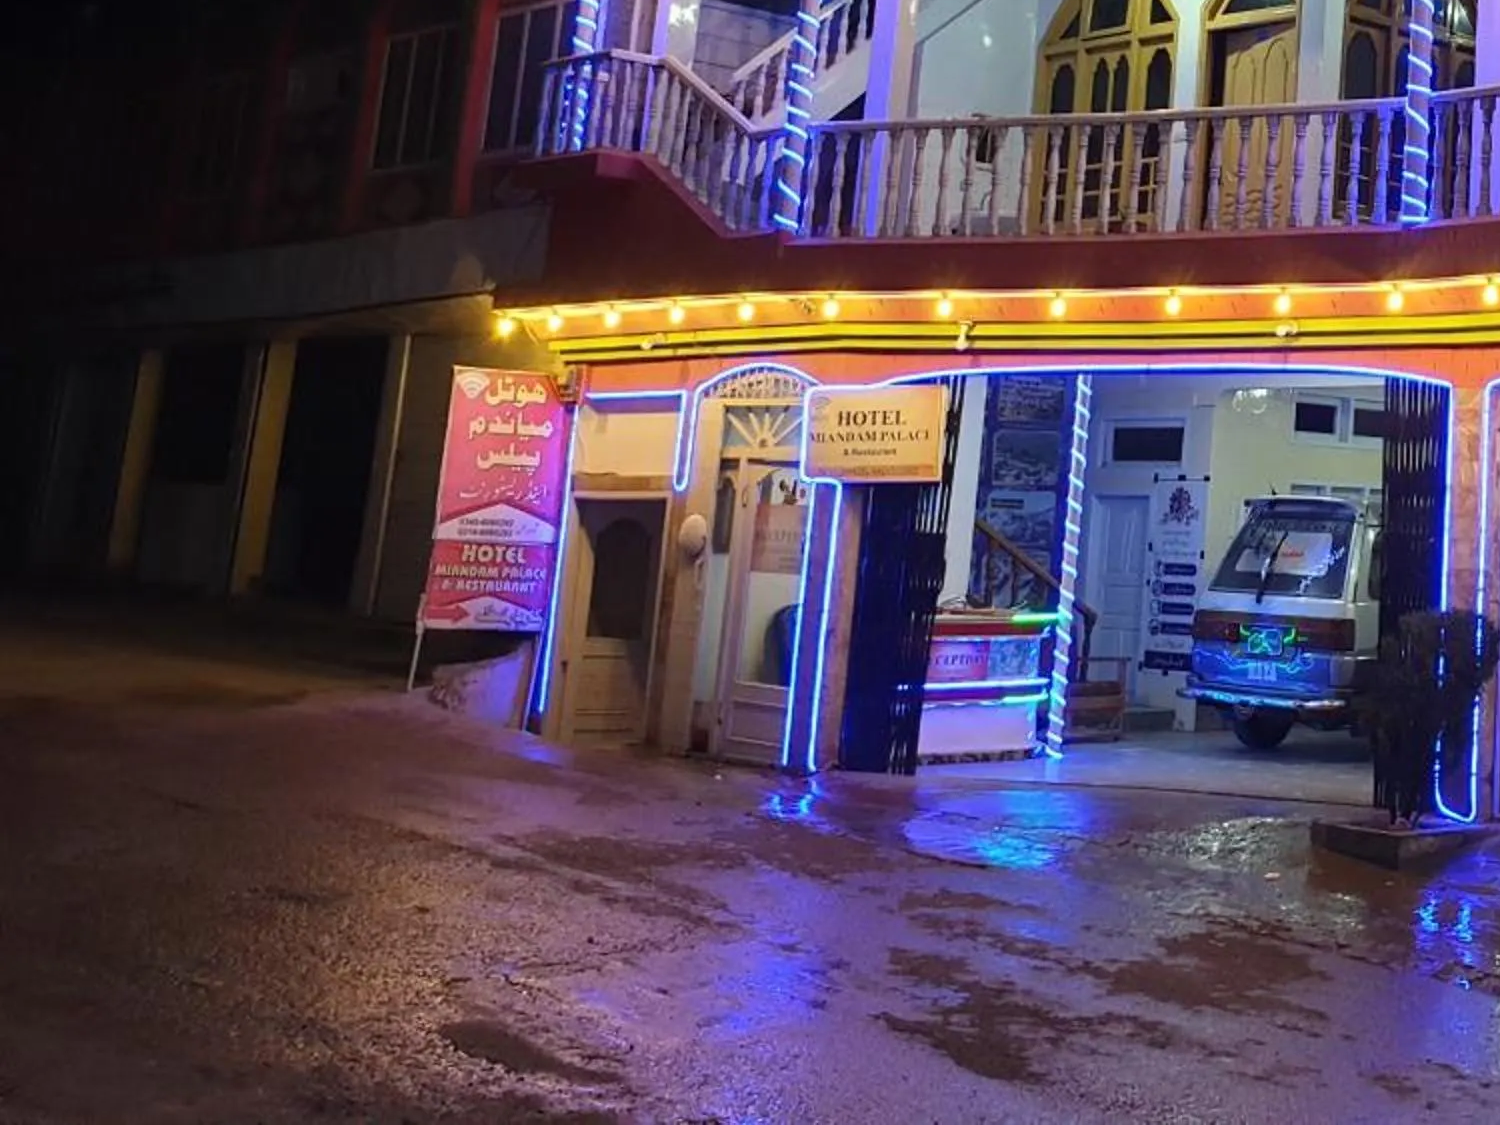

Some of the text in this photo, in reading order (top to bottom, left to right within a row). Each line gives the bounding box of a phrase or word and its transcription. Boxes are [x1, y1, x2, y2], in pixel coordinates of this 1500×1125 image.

[467, 411, 553, 441] میاندم
[837, 410, 906, 427] HOTEL
[462, 544, 527, 564] HOTEL
